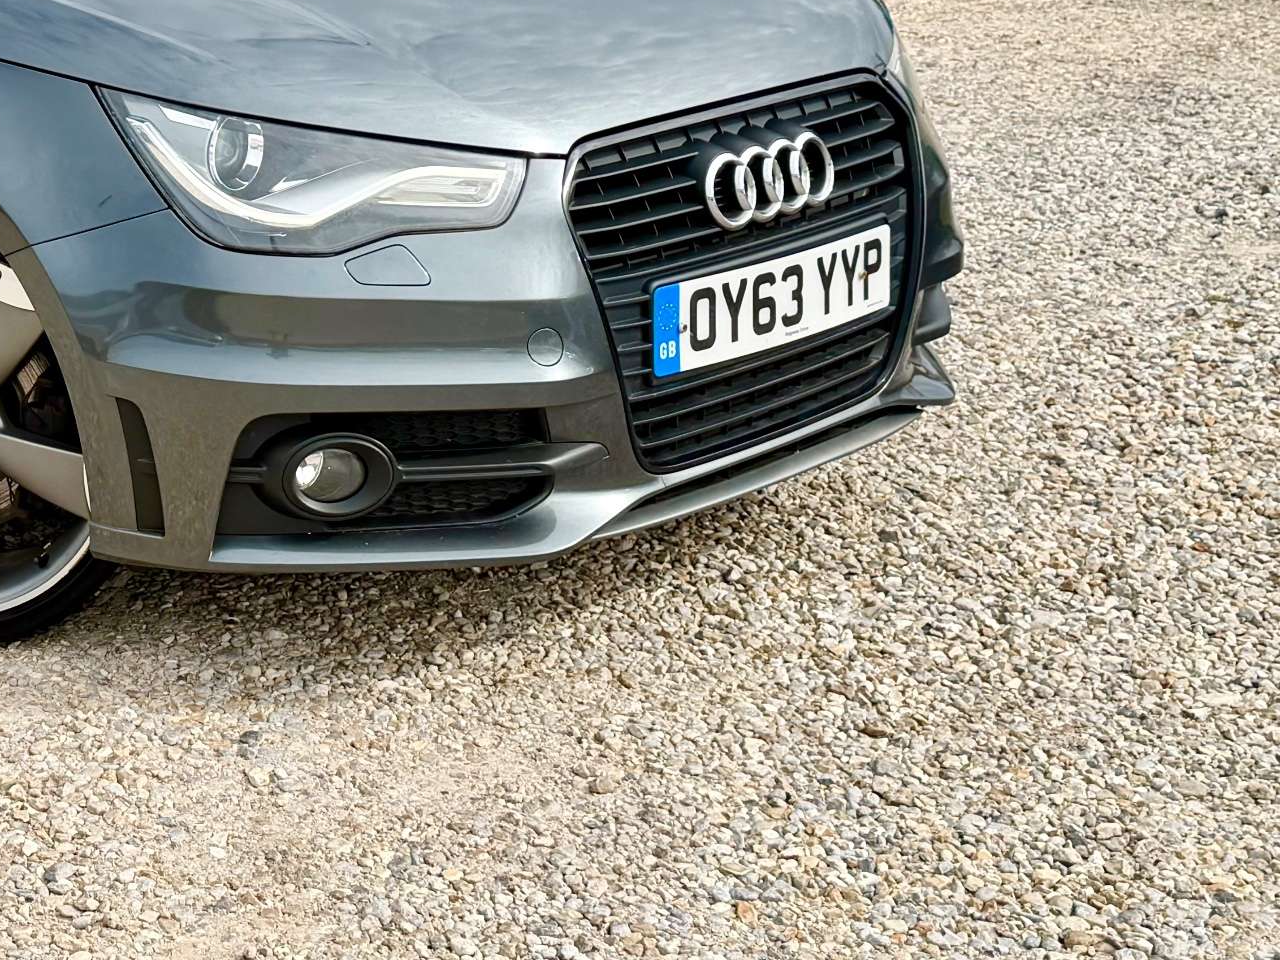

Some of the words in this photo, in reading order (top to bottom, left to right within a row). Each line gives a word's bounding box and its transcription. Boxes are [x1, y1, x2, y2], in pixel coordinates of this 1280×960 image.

[689, 263, 804, 352] OY63
[817, 238, 882, 316] YYP
[659, 341, 677, 360] GB
